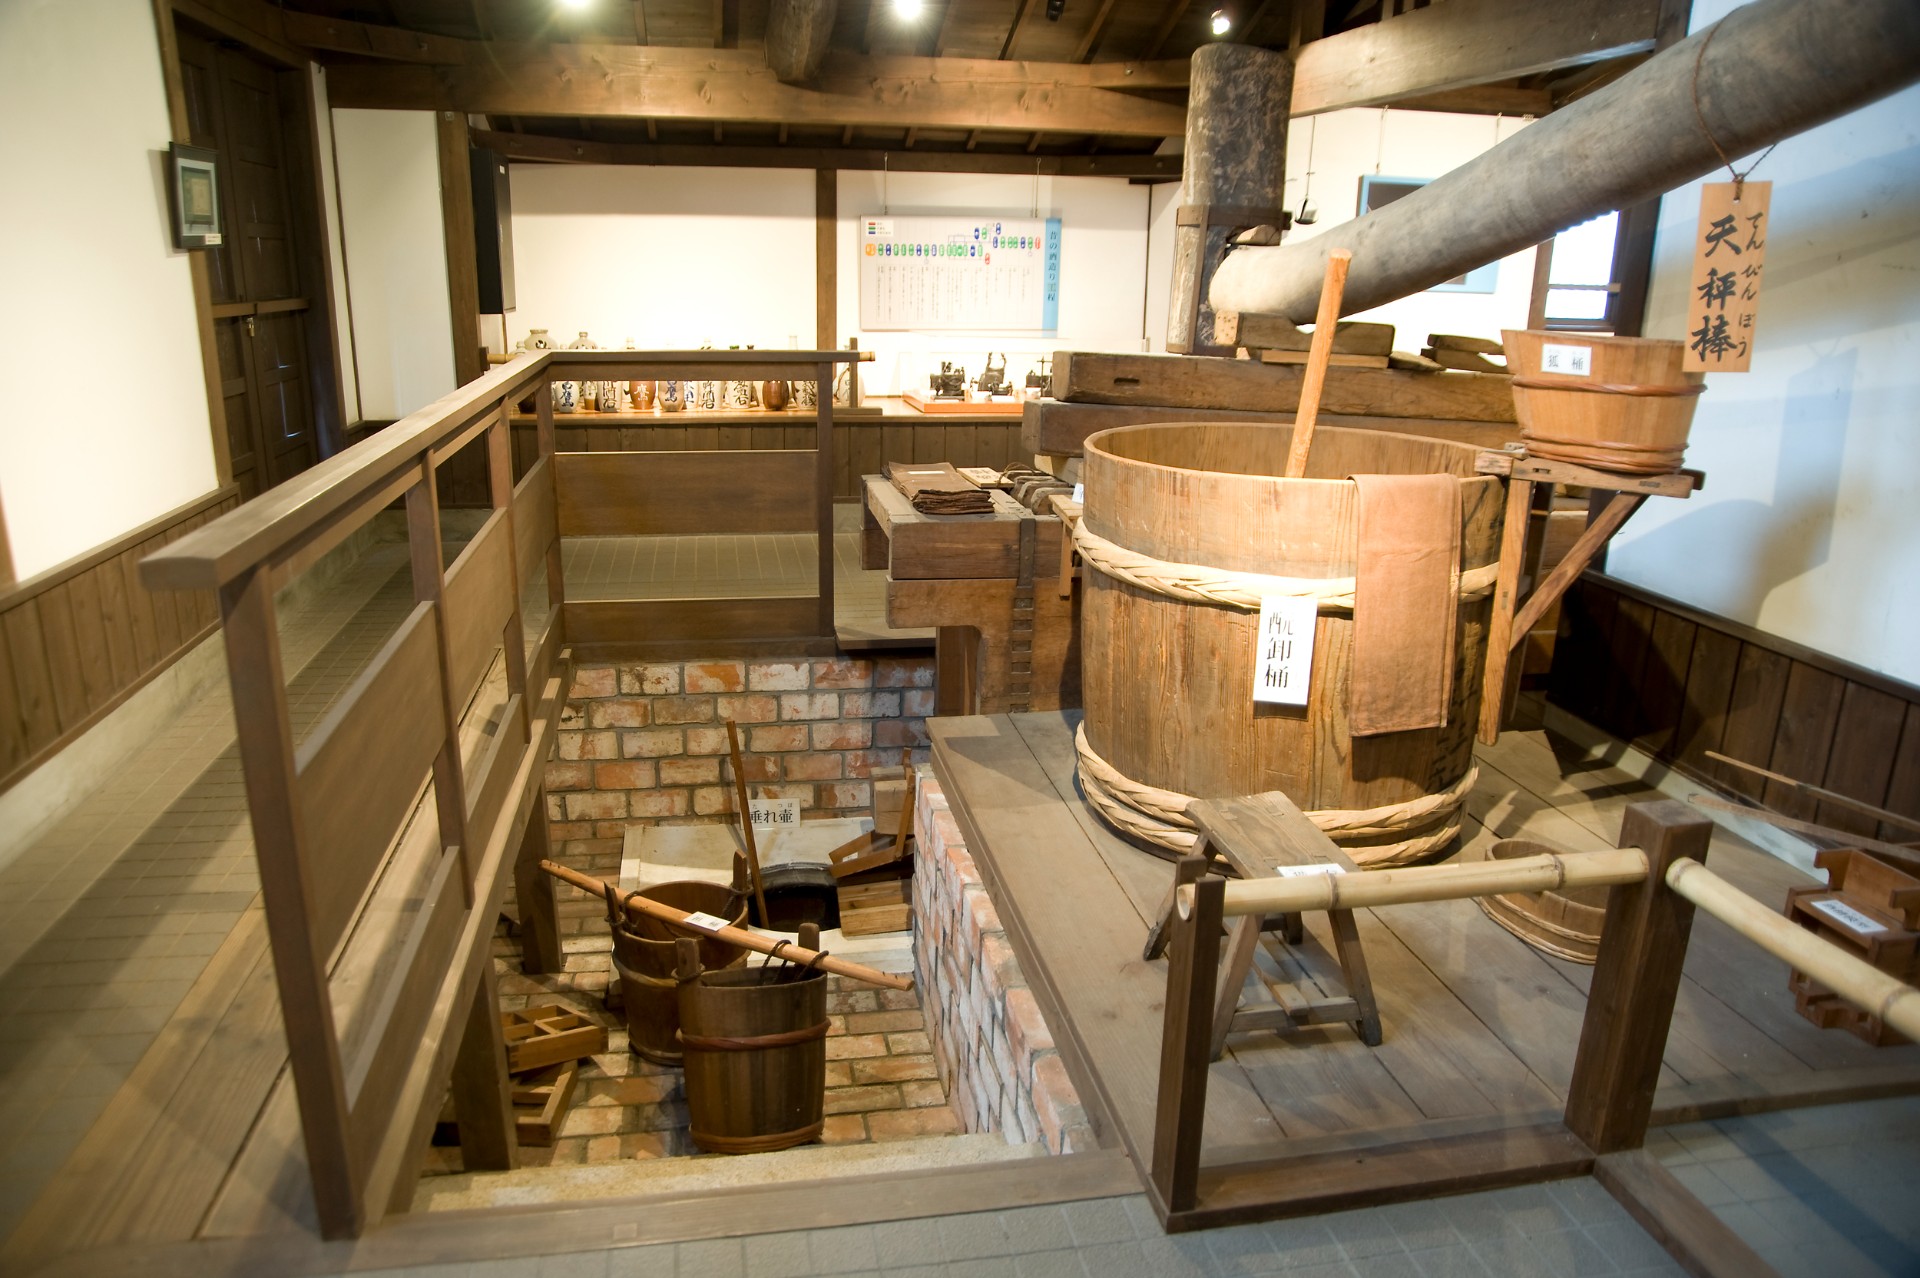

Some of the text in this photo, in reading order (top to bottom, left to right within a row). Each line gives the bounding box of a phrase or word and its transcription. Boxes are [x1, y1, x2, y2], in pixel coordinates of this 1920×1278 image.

[1047, 231, 1058, 302] 昔の酒造り工程
[1691, 214, 1742, 362] 天秤棒
[1736, 212, 1765, 358] てんびんぼう
